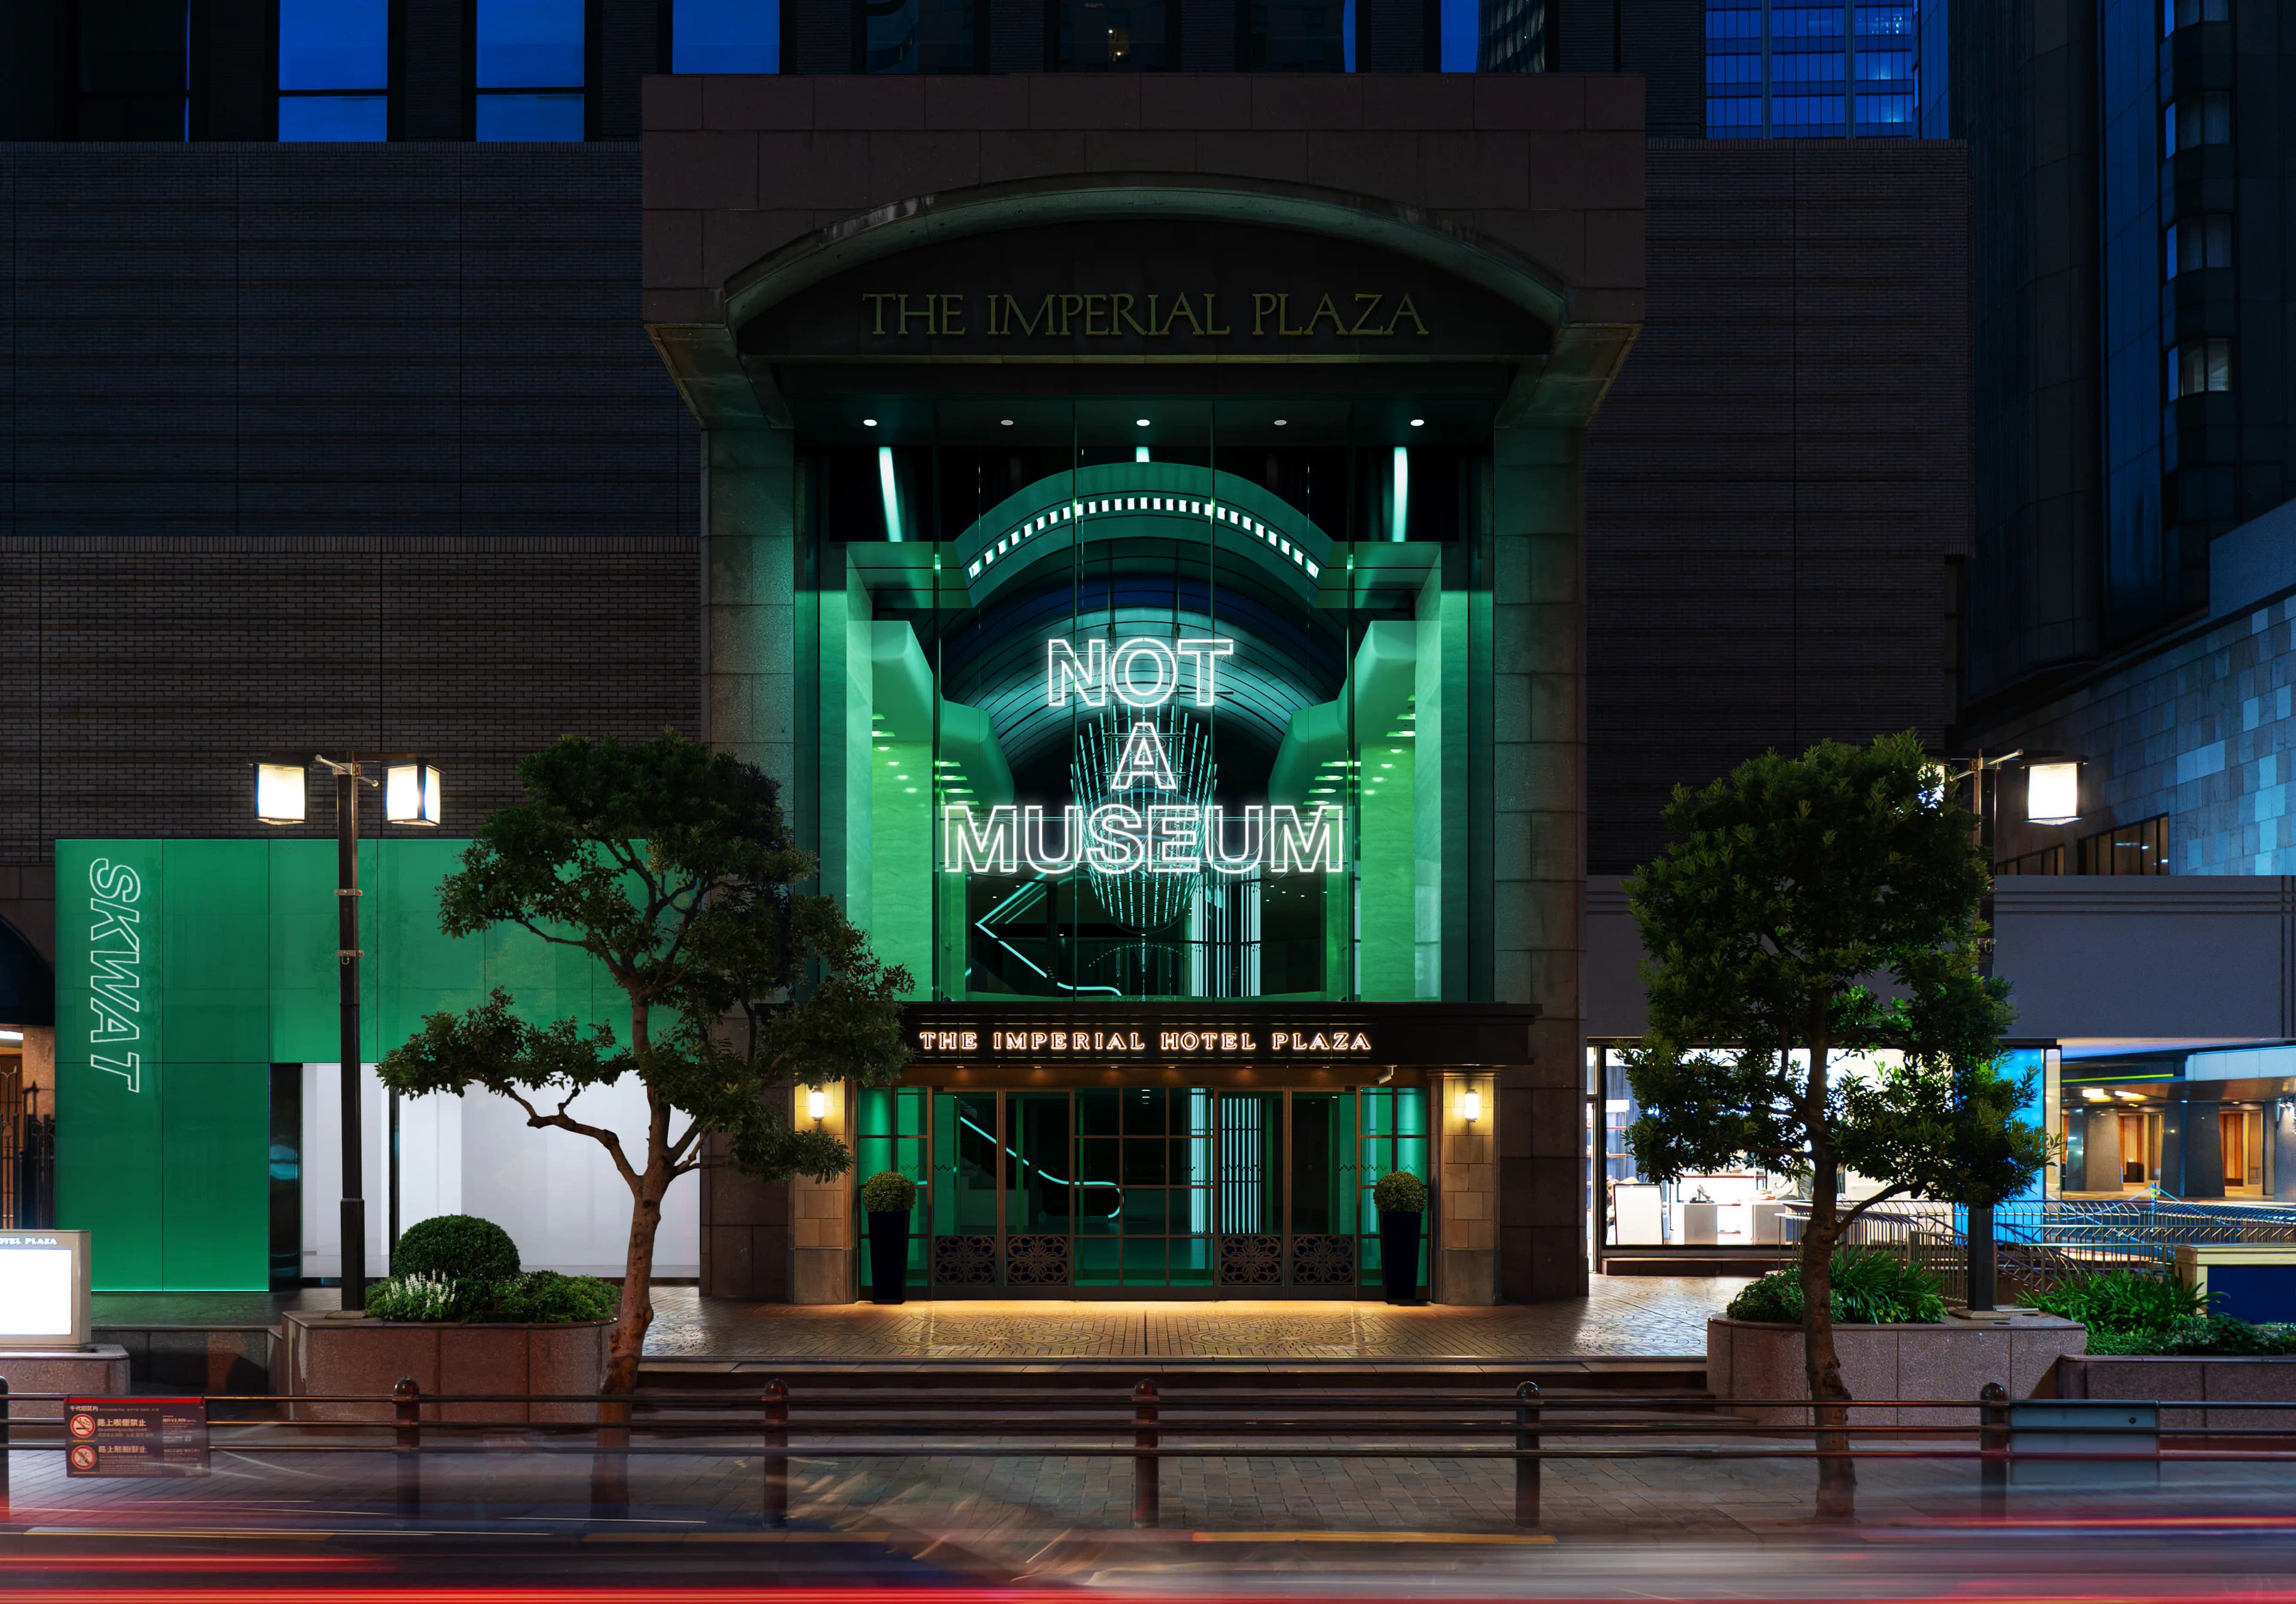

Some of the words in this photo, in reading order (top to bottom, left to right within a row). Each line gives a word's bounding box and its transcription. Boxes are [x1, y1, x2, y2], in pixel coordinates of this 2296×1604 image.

[862, 294, 966, 335] THE
[987, 292, 1231, 336] IMPERIAL
[1253, 292, 1429, 336] PLAZA
[1047, 637, 1234, 707] NOT
[1110, 722, 1177, 790] A
[944, 803, 1344, 875] MUSEUM
[89, 857, 141, 1093] SKWAT
[919, 1031, 978, 1050] THE
[993, 1031, 1146, 1050] IMPERIAL
[1160, 1031, 1256, 1051] HOTEL
[1272, 1031, 1372, 1050] PLAZA
